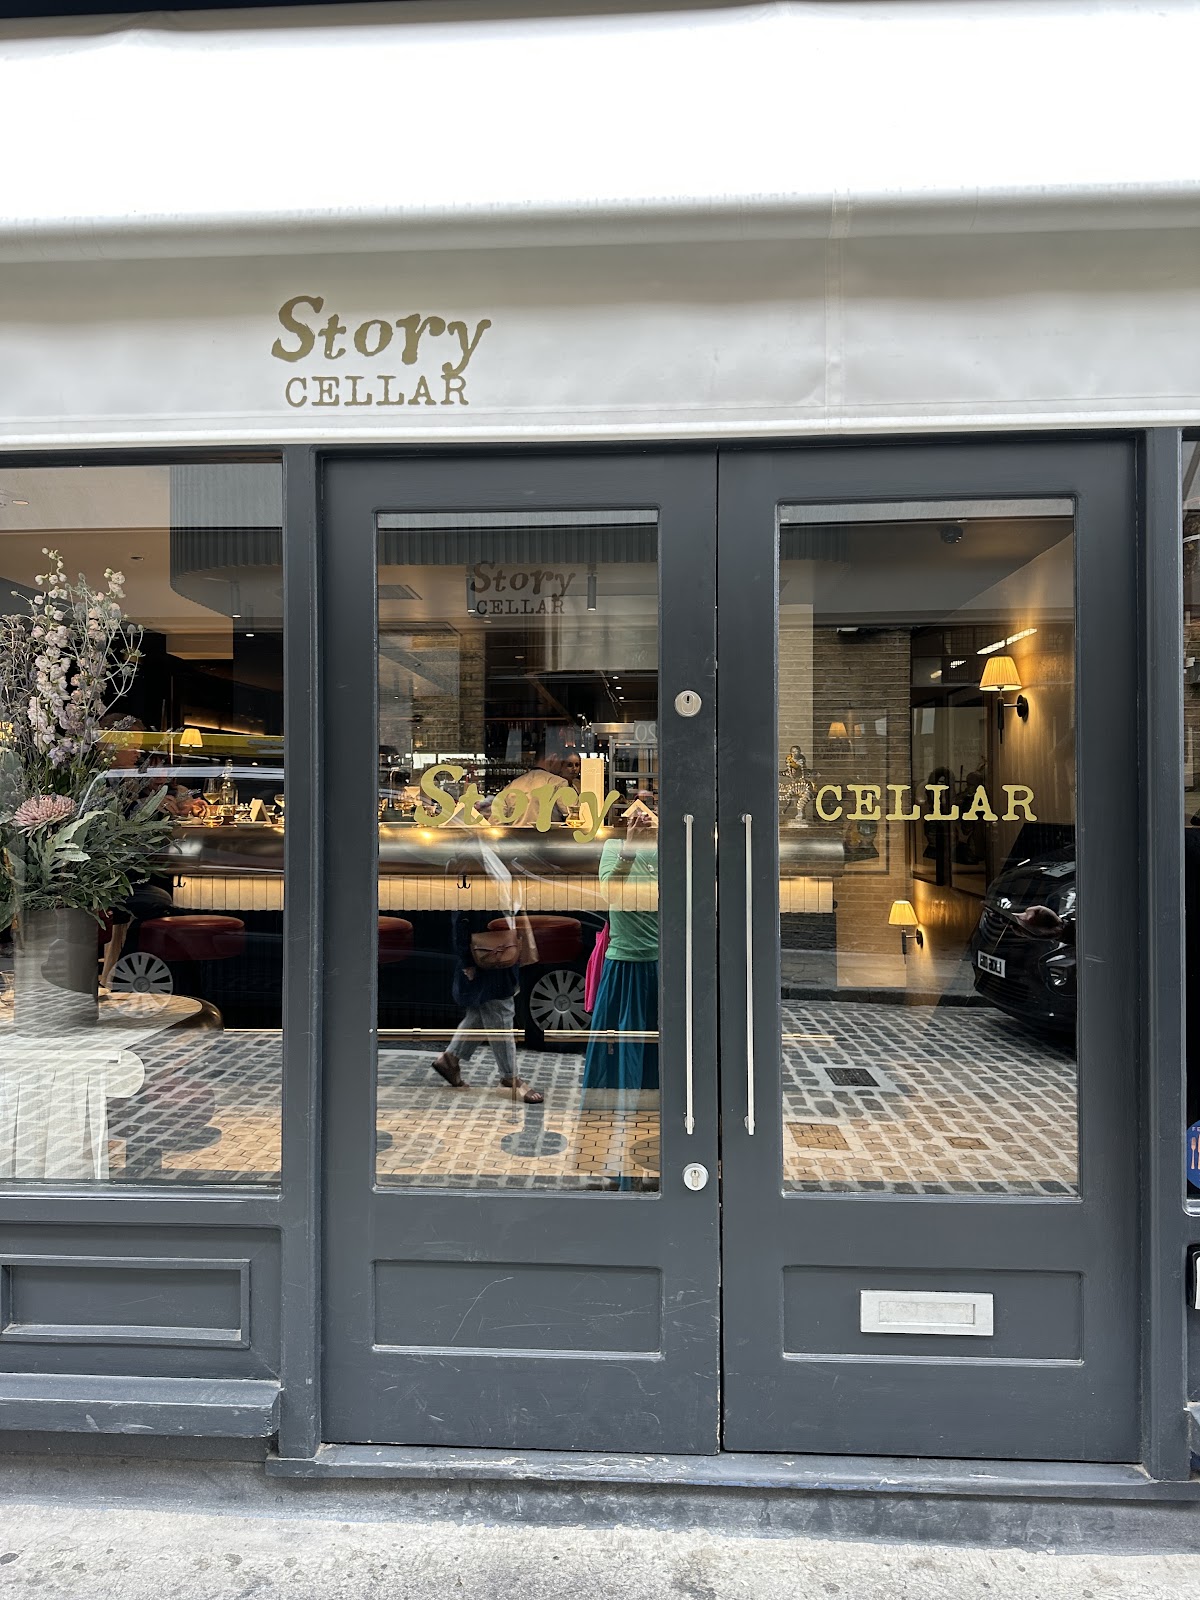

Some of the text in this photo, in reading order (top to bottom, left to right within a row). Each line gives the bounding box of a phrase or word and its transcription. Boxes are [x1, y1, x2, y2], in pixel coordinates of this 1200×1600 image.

[271, 295, 491, 376] Story
[285, 375, 469, 407] CELLAR
[470, 561, 576, 602] Story
[477, 599, 565, 614] CELLAR
[413, 764, 621, 843] Story
[815, 784, 1038, 822] CELLAR
